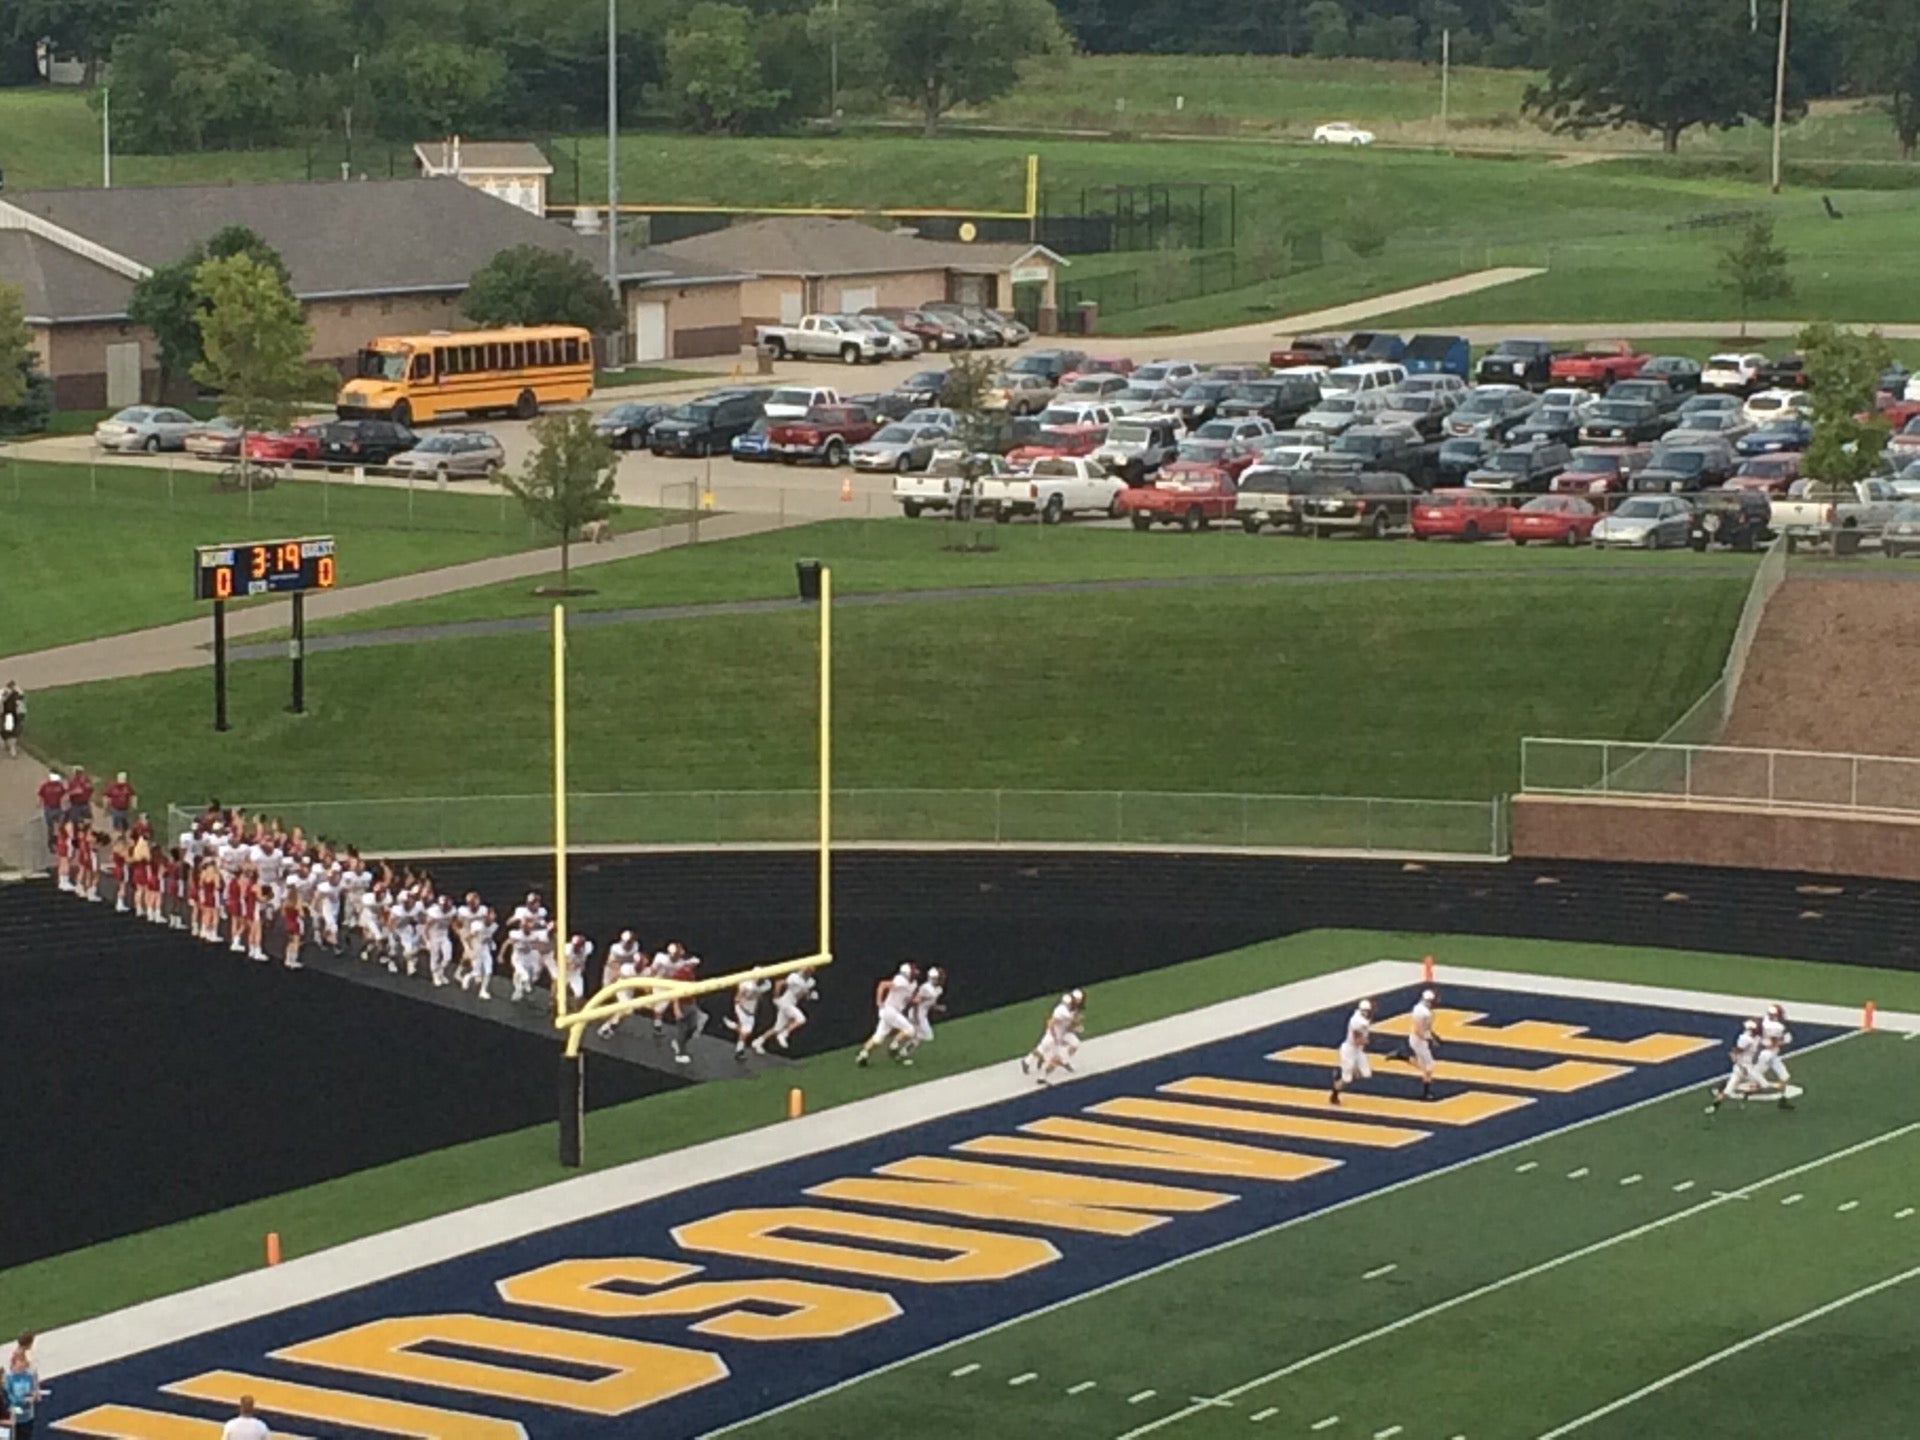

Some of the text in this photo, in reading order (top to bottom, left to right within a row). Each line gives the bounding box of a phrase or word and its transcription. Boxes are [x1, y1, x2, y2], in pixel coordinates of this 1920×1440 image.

[252, 543, 300, 578] 3:19
[318, 557, 333, 587] 0
[216, 567, 232, 598] 0
